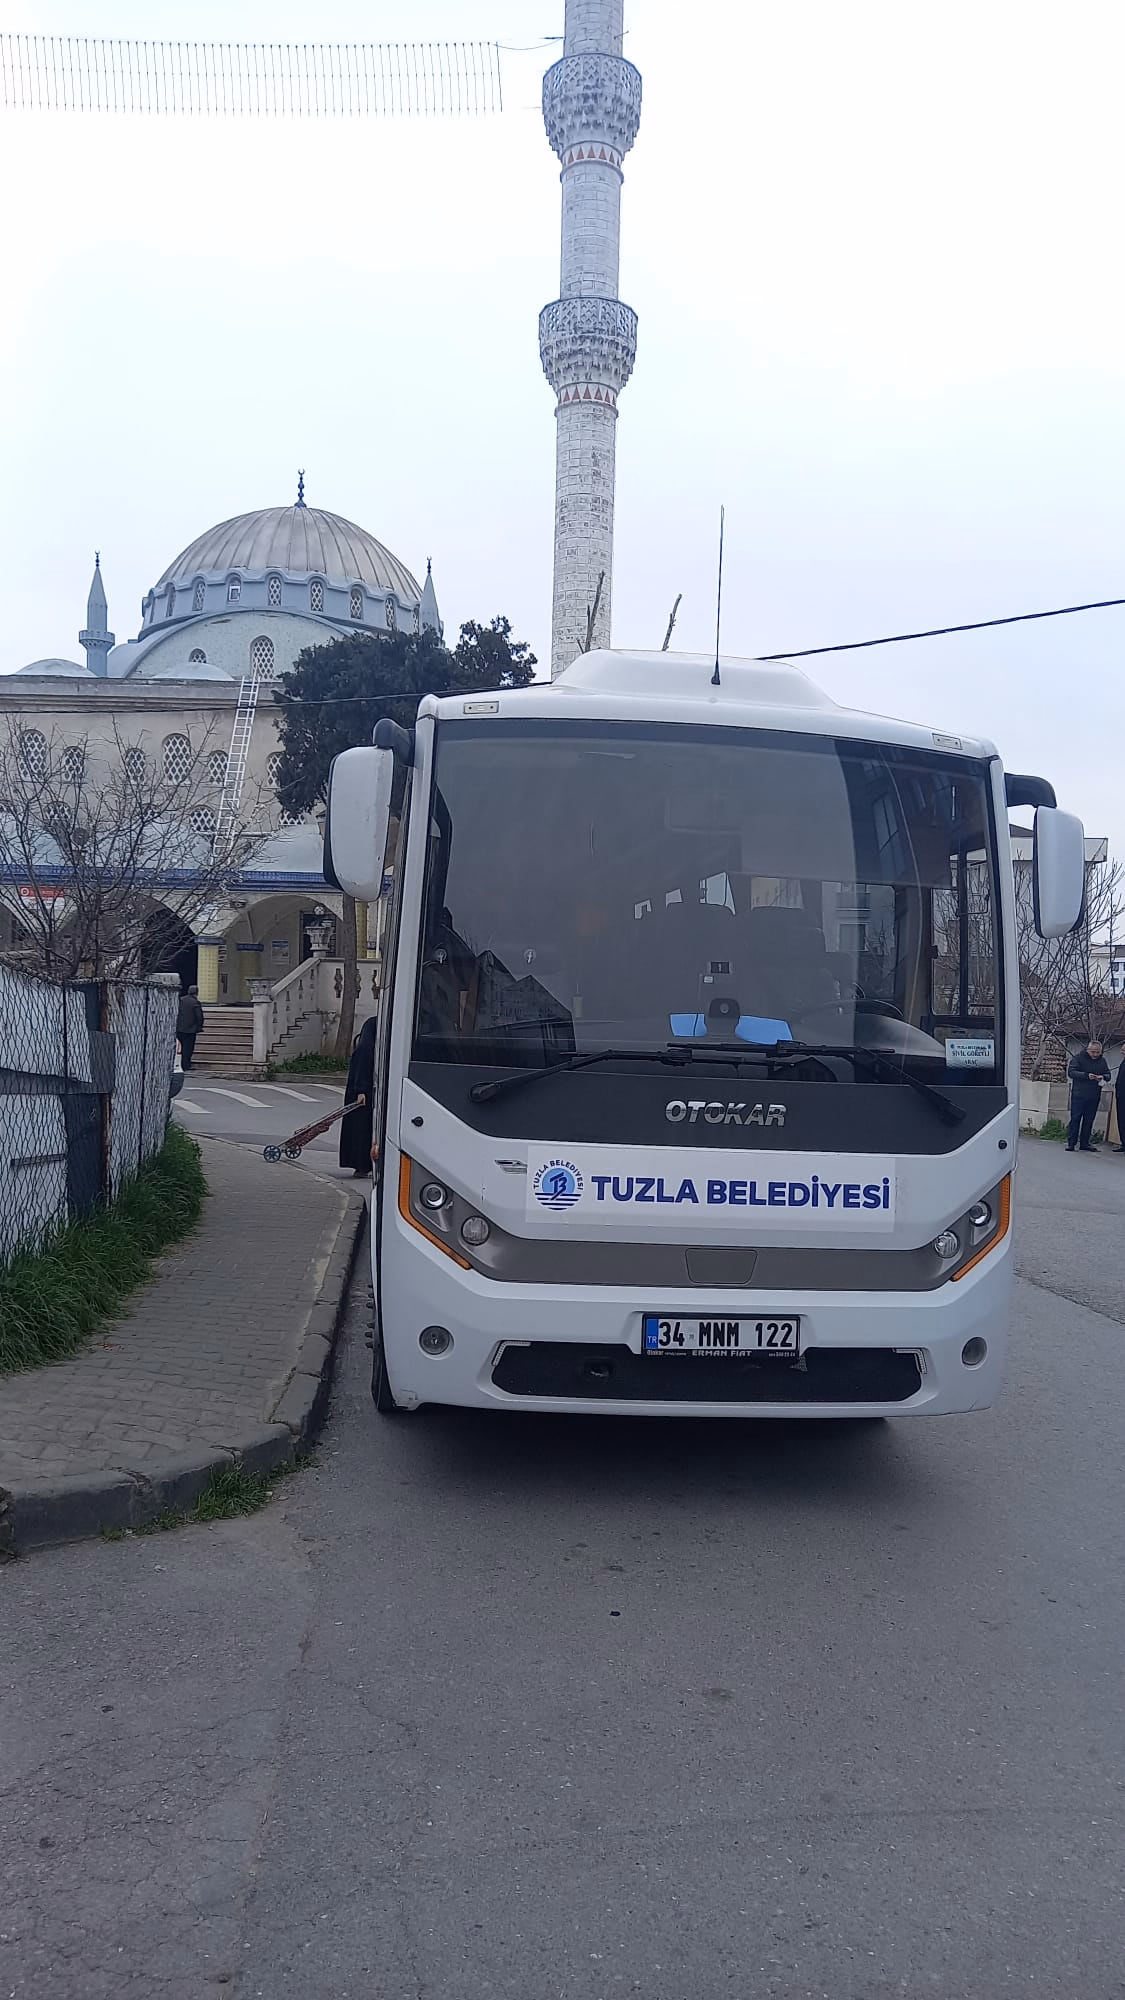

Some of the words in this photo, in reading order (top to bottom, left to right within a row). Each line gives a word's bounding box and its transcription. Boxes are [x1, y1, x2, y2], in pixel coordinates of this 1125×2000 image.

[665, 1100, 787, 1127] OTOKAR
[533, 1164, 549, 1190] TUZLA
[592, 1175, 700, 1204] TUZLA
[706, 1174, 891, 1209] BELEDİYESİ
[647, 1335, 657, 1344] TR
[658, 1321, 685, 1347] 34
[698, 1321, 740, 1348] MNM
[755, 1322, 793, 1348] 122
[691, 1349, 728, 1357] ERMAN
